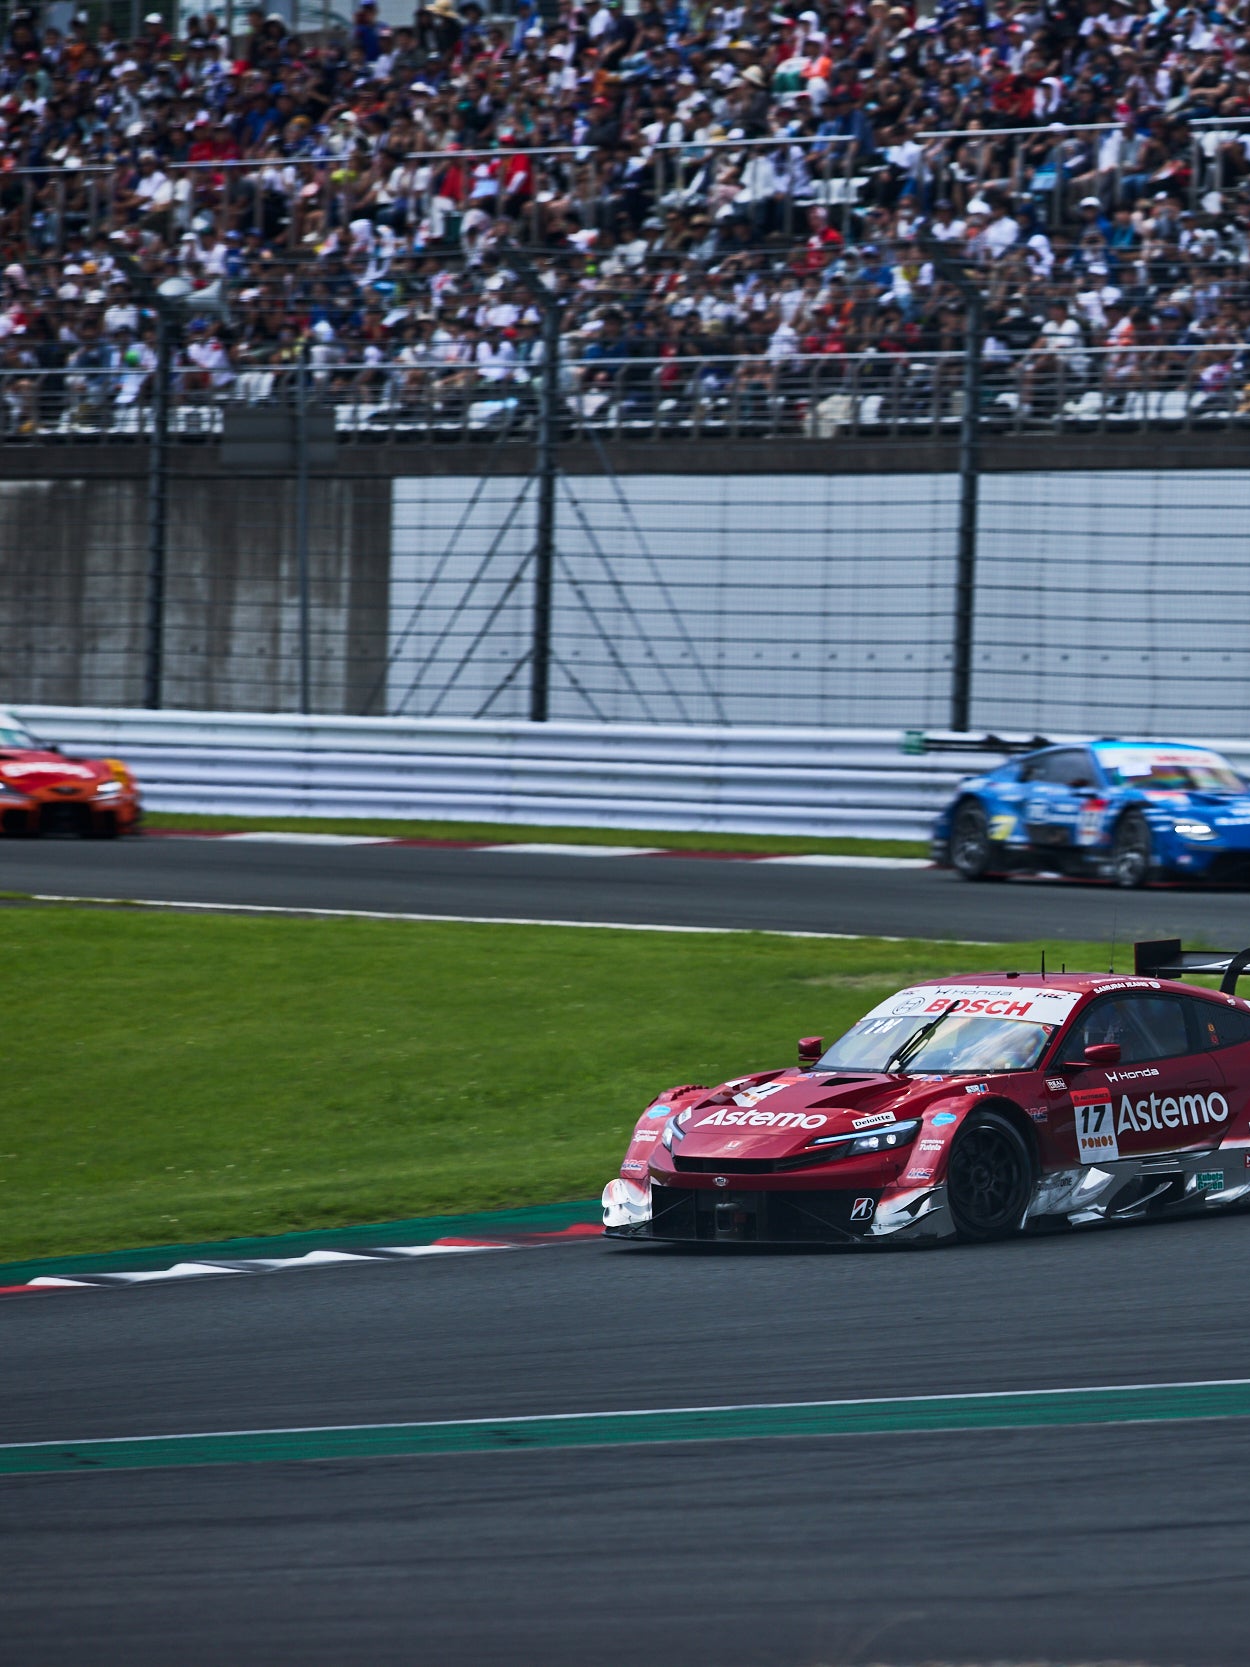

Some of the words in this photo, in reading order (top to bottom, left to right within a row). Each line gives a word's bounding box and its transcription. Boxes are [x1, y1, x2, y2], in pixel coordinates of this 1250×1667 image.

[924, 998, 1033, 1017] BOSCH
[1118, 1067, 1160, 1080] Honda
[693, 1108, 828, 1130] Astemo
[1081, 1105, 1106, 1134] 17
[1117, 1091, 1229, 1136] Astemo
[1081, 1135, 1114, 1150] PONOS
